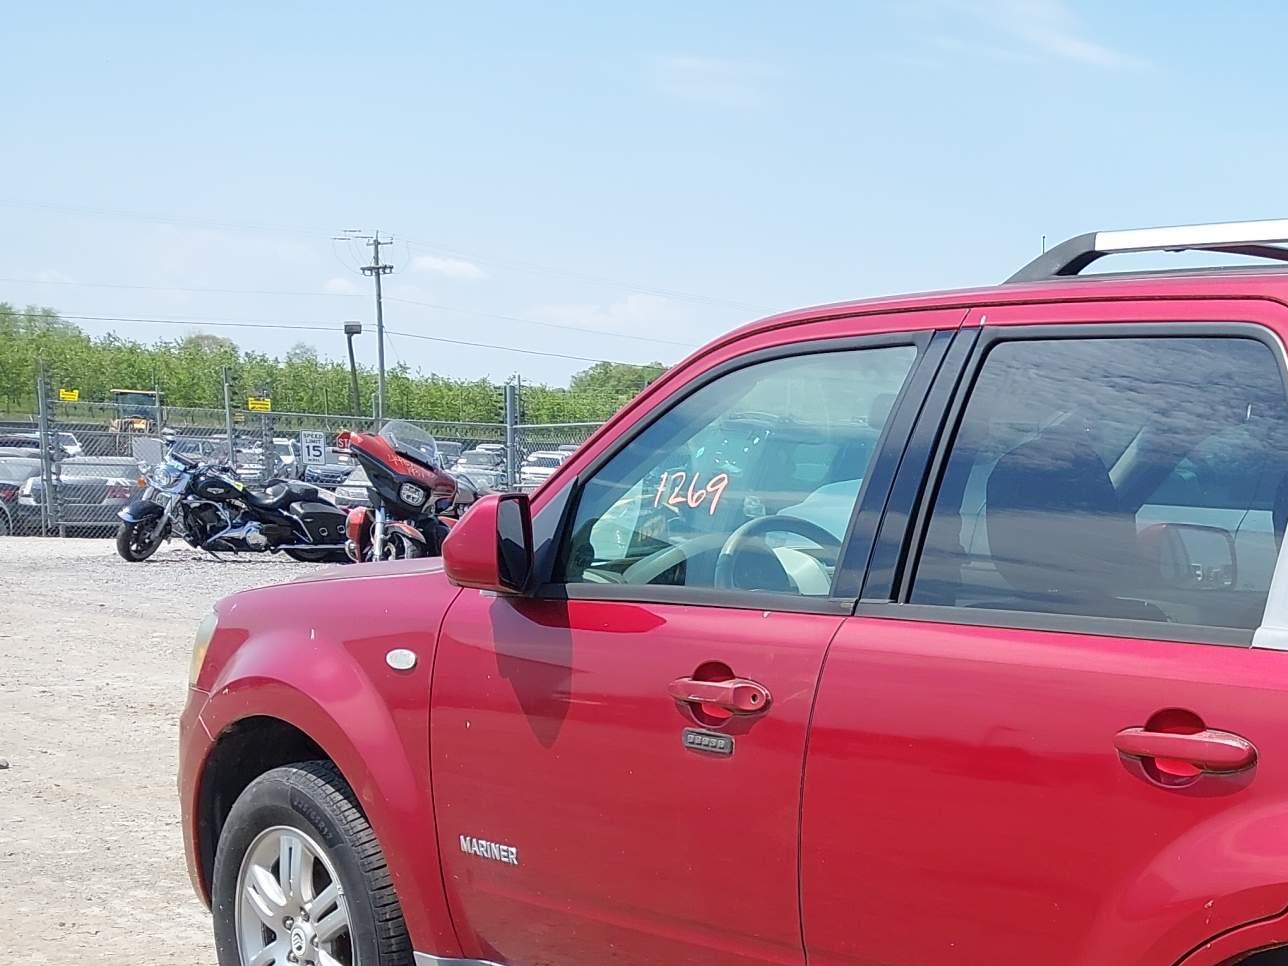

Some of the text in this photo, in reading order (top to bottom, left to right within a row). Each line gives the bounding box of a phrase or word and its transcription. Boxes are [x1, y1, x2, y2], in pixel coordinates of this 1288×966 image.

[306, 445, 322, 457] 15
[654, 472, 728, 515] 1269
[460, 835, 518, 864] MARINER
